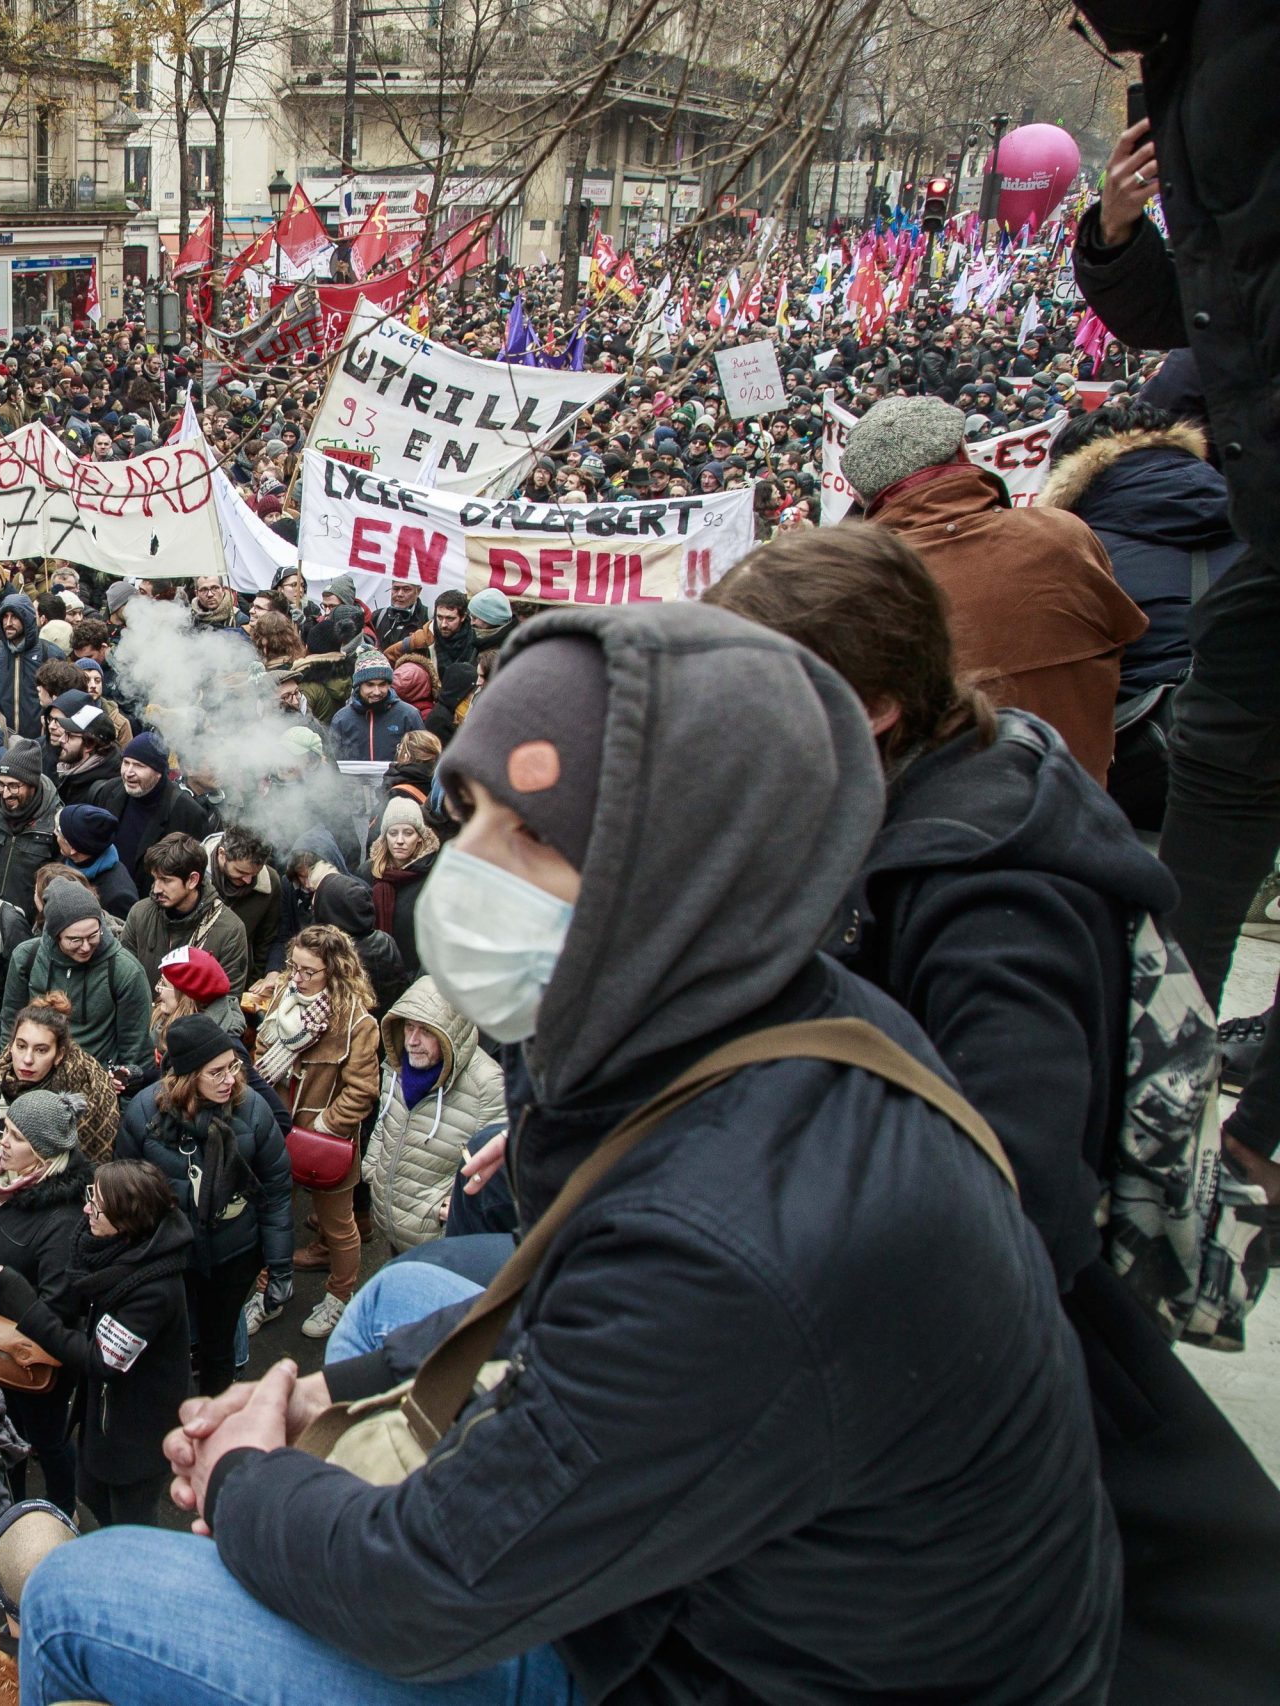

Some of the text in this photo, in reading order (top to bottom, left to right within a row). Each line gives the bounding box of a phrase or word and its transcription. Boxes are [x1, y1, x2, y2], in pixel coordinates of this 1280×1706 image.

[378, 320, 433, 357] LYCÉE
[338, 397, 378, 437] 93
[402, 428, 480, 473] EN
[323, 459, 430, 517] LYCÉE
[459, 500, 703, 539] D'ALEMBERT
[348, 516, 448, 586] EN
[488, 548, 663, 606] DEUIL
